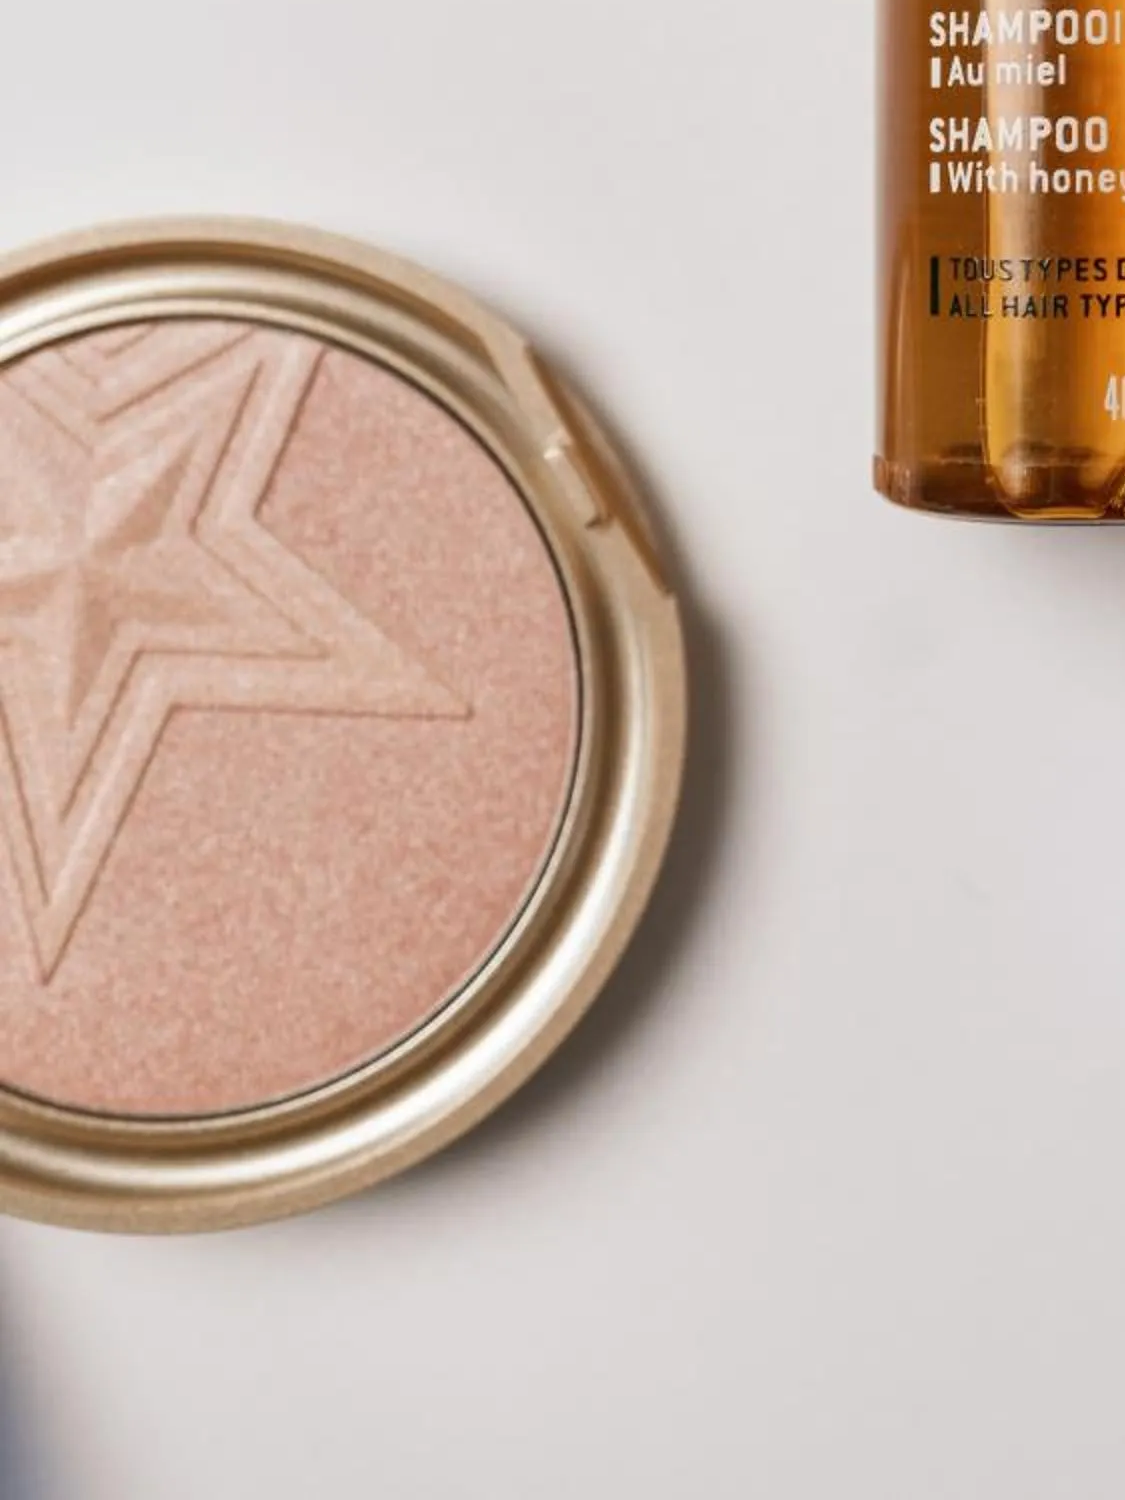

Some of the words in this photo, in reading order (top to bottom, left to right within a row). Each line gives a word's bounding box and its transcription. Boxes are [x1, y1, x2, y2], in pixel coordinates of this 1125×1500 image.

[947, 54, 985, 87] Au
[995, 53, 1067, 86] miel
[928, 115, 1109, 153] SHAMPOO
[947, 160, 1019, 194] With
[949, 256, 1014, 283] TOUS
[1020, 256, 1108, 283] TYPES
[949, 293, 994, 318] ALL
[1001, 293, 1069, 318] HAIR
